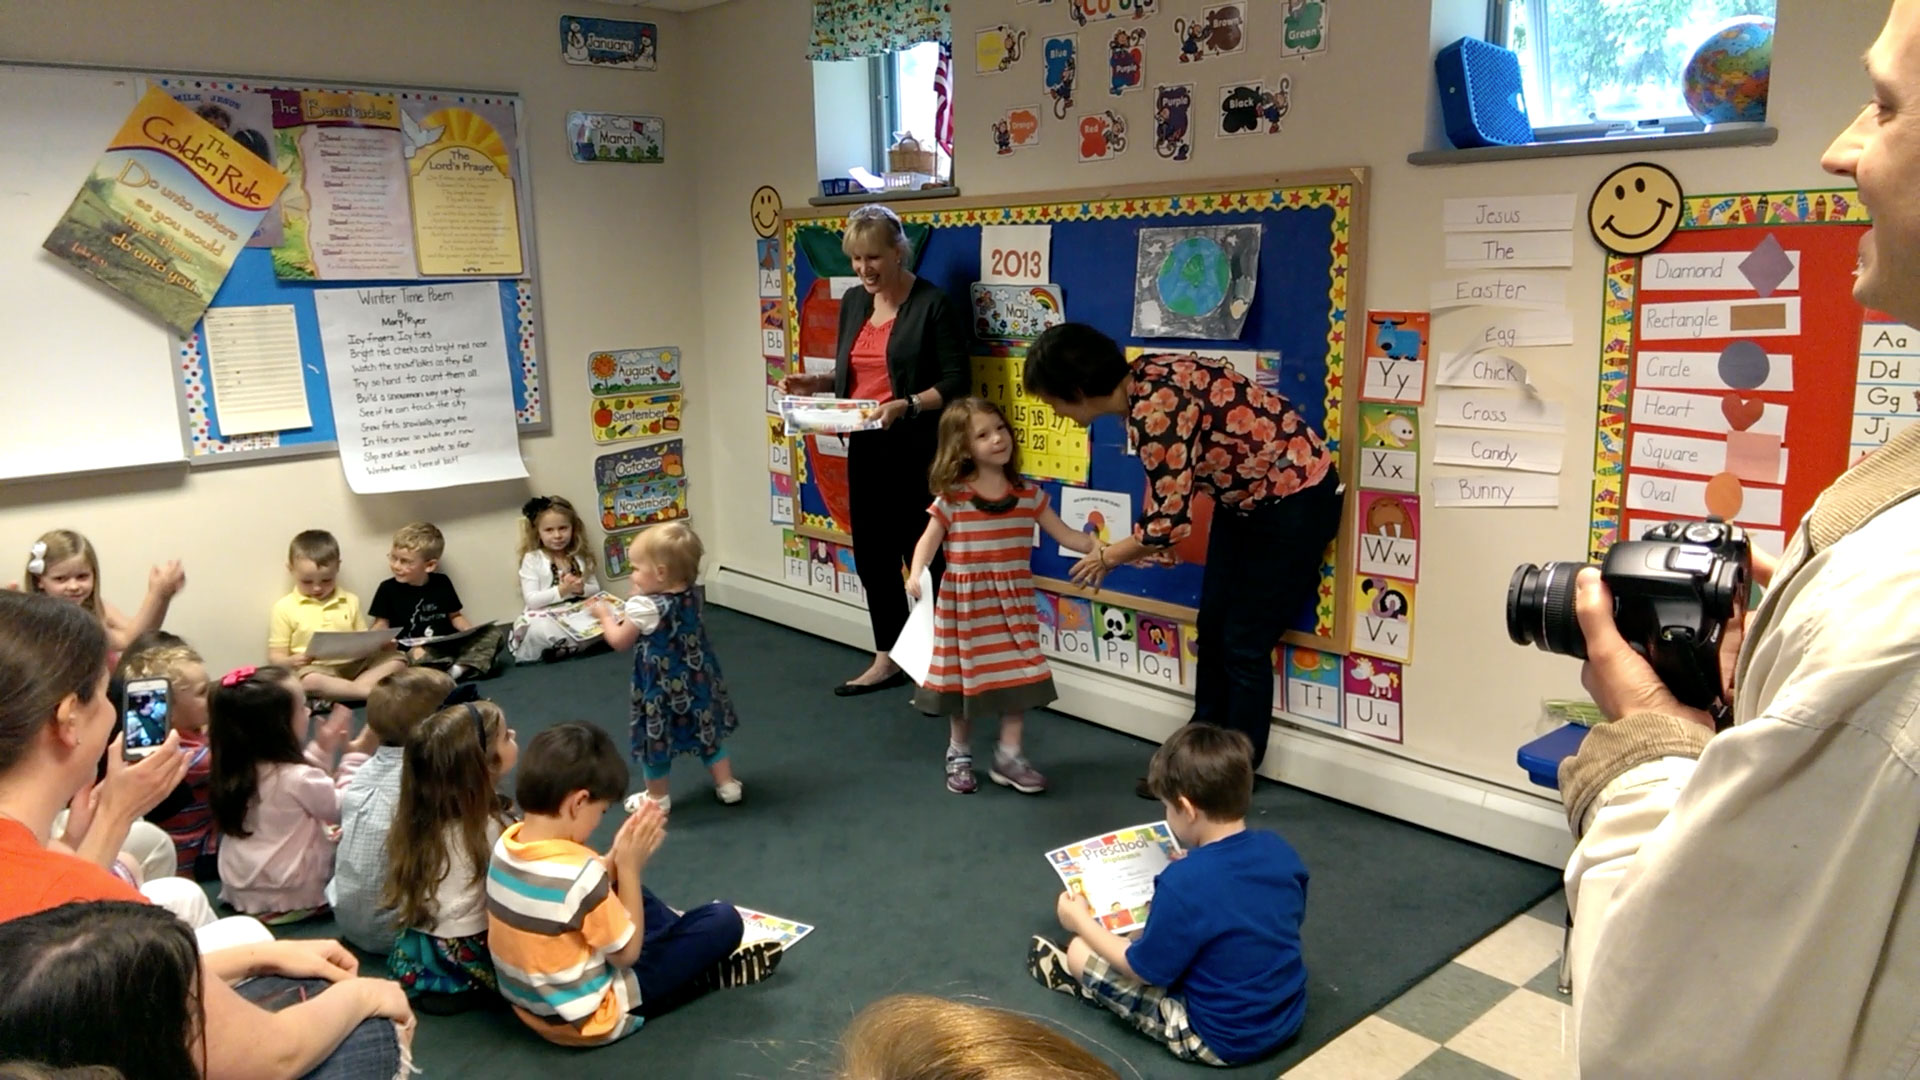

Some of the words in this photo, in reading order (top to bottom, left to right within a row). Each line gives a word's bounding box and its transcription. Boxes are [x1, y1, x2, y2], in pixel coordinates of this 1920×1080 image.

[1213, 18, 1240, 27] Brown
[588, 35, 633, 53] January
[1288, 29, 1317, 40] Green
[1050, 49, 1067, 59] Blue
[272, 98, 298, 114] The
[1162, 97, 1188, 107] Purple
[1229, 98, 1254, 109] Black
[1085, 124, 1099, 133] Red
[208, 134, 230, 159] The
[600, 133, 636, 145] March
[142, 116, 218, 176] Golden
[217, 164, 261, 205] Rule
[450, 149, 469, 161] The
[429, 159, 460, 171] Lord's
[463, 162, 494, 176] Prayer
[117, 158, 160, 189] Do
[160, 187, 194, 211] unto
[195, 209, 238, 241] others
[1476, 204, 1520, 224] Jesus
[151, 208, 180, 231] you
[183, 227, 225, 257] would
[111, 232, 132, 253] do
[133, 249, 167, 273] unto
[1482, 240, 1515, 260] The
[991, 249, 1042, 278] 2013
[1655, 258, 1724, 279] Diamond
[357, 289, 396, 305] Winter
[400, 287, 424, 303] Time
[428, 287, 454, 302] Poem
[1456, 280, 1527, 300] Easter
[1005, 303, 1029, 323] May
[1646, 308, 1720, 337] Rectangle
[1485, 326, 1516, 347] Egg
[1873, 331, 1907, 348] Aa
[420, 344, 434, 353] and
[378, 363, 391, 371] the
[618, 365, 655, 380] August
[1473, 361, 1519, 382] Chick
[1646, 357, 1691, 377] Circle
[1869, 361, 1901, 379] Dd
[353, 378, 368, 390] Try
[371, 378, 381, 387] so
[406, 373, 417, 383] to
[420, 372, 443, 382] count
[445, 370, 465, 379] them
[1015, 383, 1023, 398] 8
[1867, 387, 1900, 414] Gg
[359, 407, 375, 418] See
[613, 408, 667, 424] September
[1643, 395, 1695, 418] Heart
[1014, 405, 1026, 422] 15
[1031, 410, 1044, 426] 16
[1051, 412, 1065, 431] 17
[1014, 427, 1026, 444] 22
[1032, 434, 1045, 450] 23
[1864, 417, 1890, 444] Jj
[1471, 441, 1517, 467] Candy
[1642, 437, 1699, 468] Square
[616, 459, 663, 476] October
[1459, 479, 1514, 505] Bunny
[1640, 480, 1677, 503] Oval
[619, 496, 671, 513] November
[1082, 835, 1149, 861] Preschool
